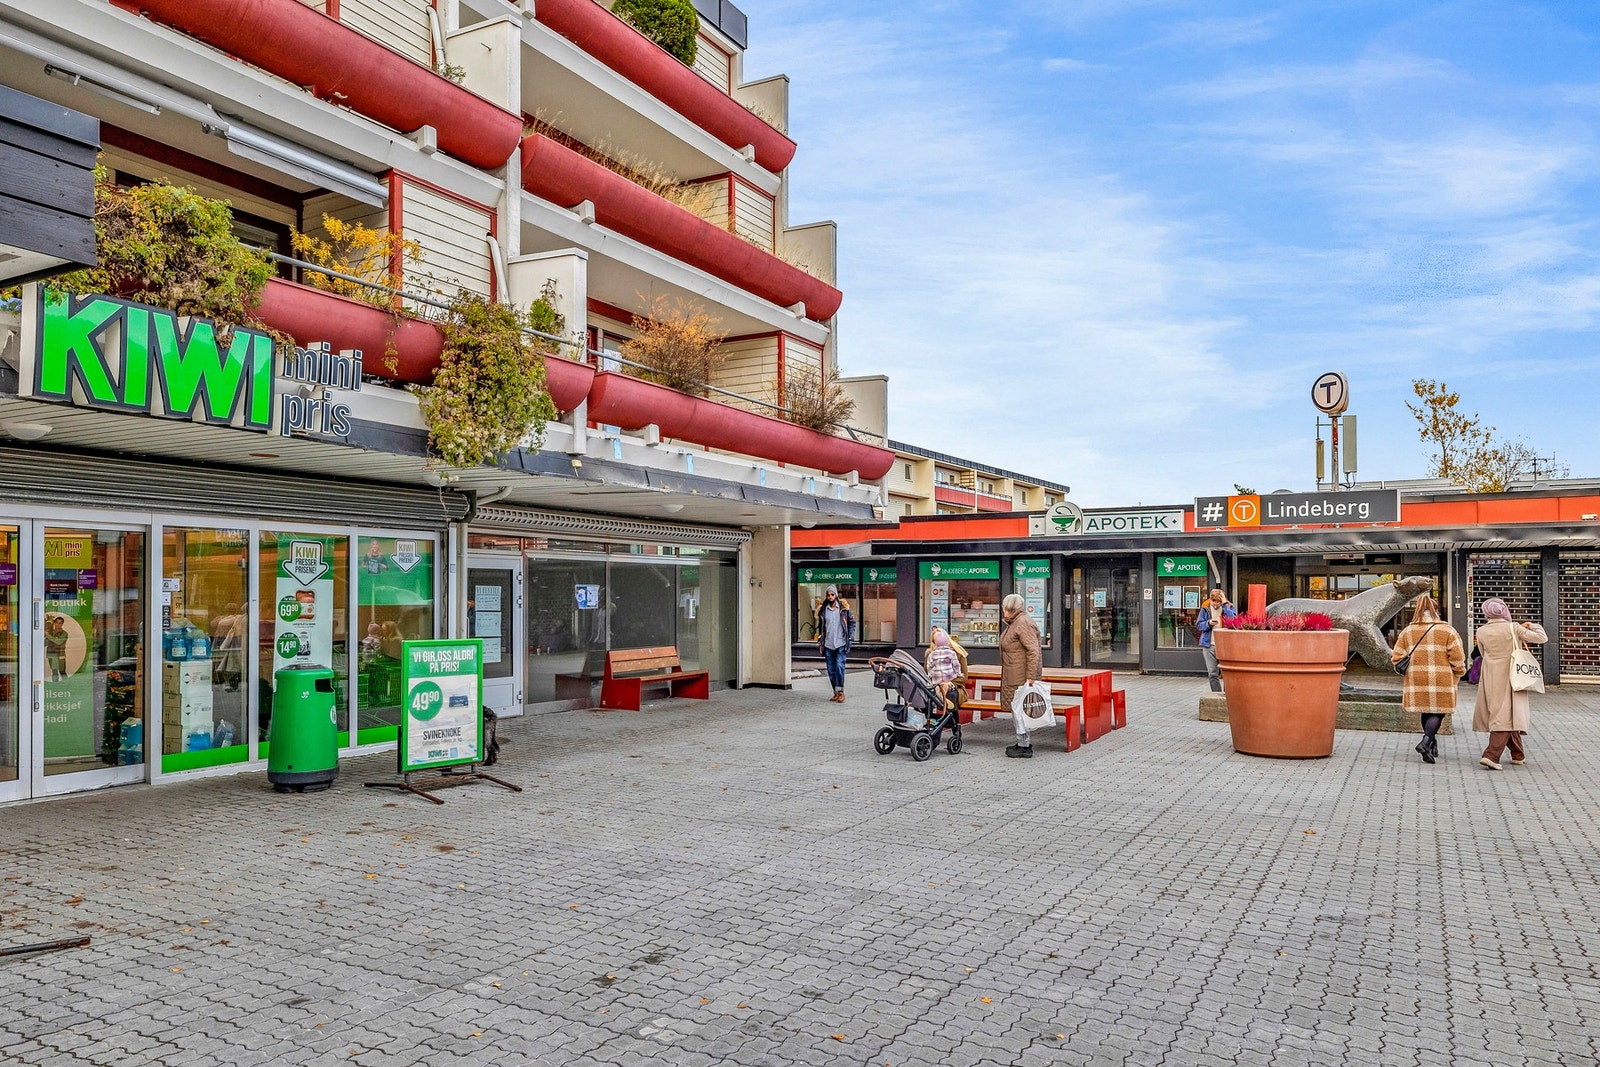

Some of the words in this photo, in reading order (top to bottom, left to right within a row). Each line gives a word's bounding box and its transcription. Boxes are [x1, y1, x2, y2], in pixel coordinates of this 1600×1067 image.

[37, 284, 275, 429] KIWI
[283, 341, 363, 392] mini
[1319, 380, 1337, 404] T
[281, 391, 353, 437] pris
[1267, 500, 1370, 519] Lindeberg
[1085, 515, 1169, 532] APOTEK
[65, 541, 82, 549] mini
[65, 549, 81, 558] pris
[295, 546, 318, 559] KIWI
[295, 558, 317, 567] PRESSER
[294, 566, 317, 575] PRISENE!
[942, 567, 968, 575] LINDEBERG
[413, 651, 421, 663] VI
[422, 650, 436, 662] GIR
[437, 650, 452, 662] OSS
[429, 660, 439, 673] PÅ
[440, 661, 460, 673] PRIS!
[45, 690, 71, 699] ilsen
[423, 726, 462, 741] SVINEKNOKE
